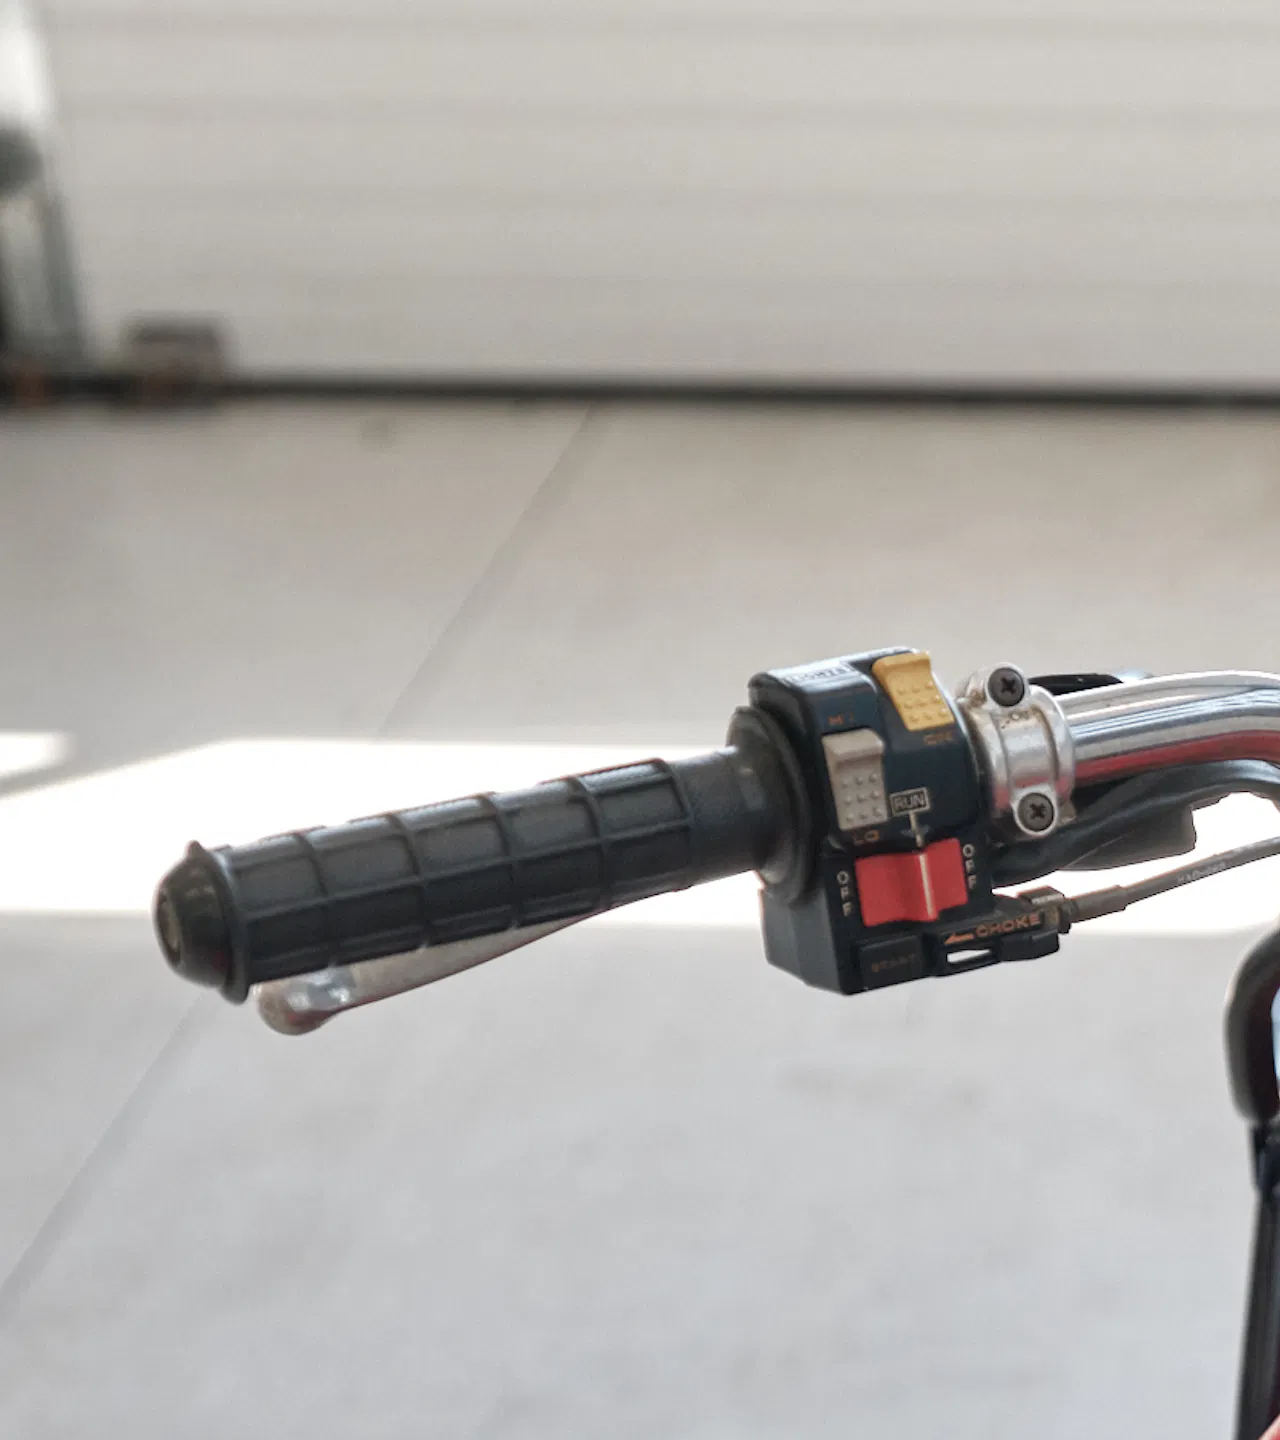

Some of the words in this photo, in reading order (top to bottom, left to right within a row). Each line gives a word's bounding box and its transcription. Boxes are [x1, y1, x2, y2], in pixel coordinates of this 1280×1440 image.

[893, 789, 925, 809] RUN
[962, 843, 977, 890] OFF
[836, 870, 852, 917] OFF
[975, 911, 1042, 938] CHOKE
